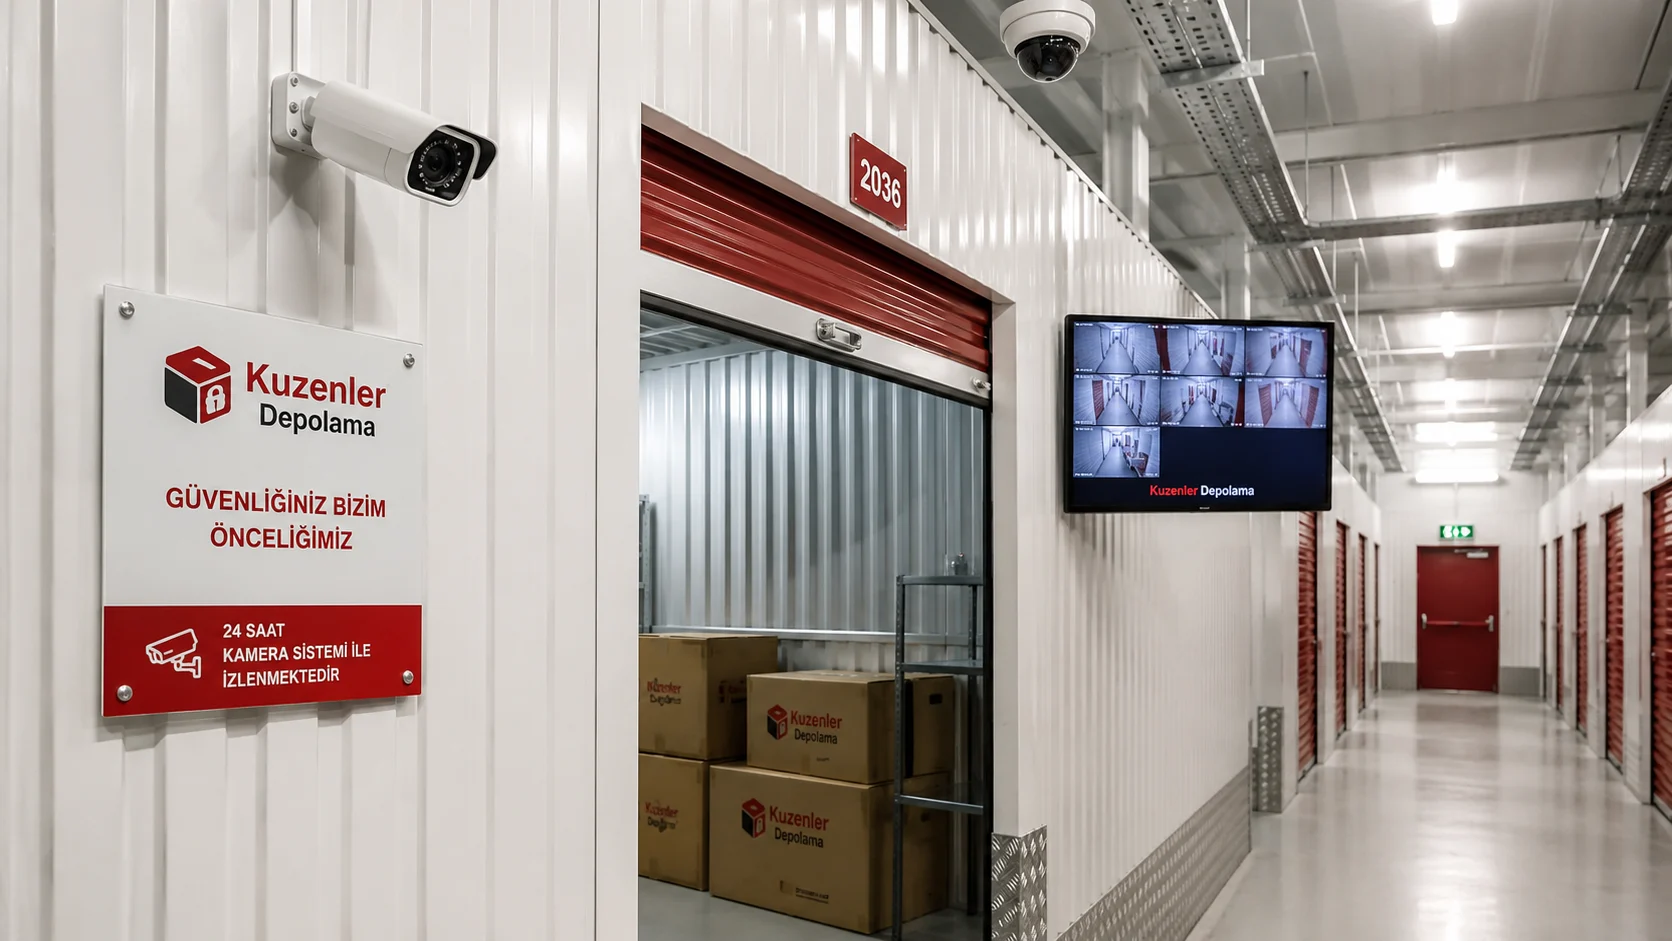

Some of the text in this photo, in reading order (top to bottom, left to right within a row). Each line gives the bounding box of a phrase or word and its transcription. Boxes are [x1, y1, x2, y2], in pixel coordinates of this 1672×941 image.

[861, 159, 901, 208] 2036
[246, 362, 386, 408] Kuzenler
[260, 404, 376, 437] Depolama
[166, 484, 386, 518] GÜVENLİĞİNİZ BİZİM
[1150, 485, 1255, 497] Kuzenler Depolama
[210, 522, 353, 550] ÖNCELİĞİMİZ
[223, 623, 285, 637] 24 SAAT
[223, 641, 370, 662] KAMERA SİSTEMİ İLE
[223, 665, 339, 688] İZLENMEKTEDİR
[791, 710, 842, 729] Kuzenler
[795, 728, 837, 744] Depolama
[770, 807, 829, 831] Kuzenler
[775, 828, 823, 848] Depolama
